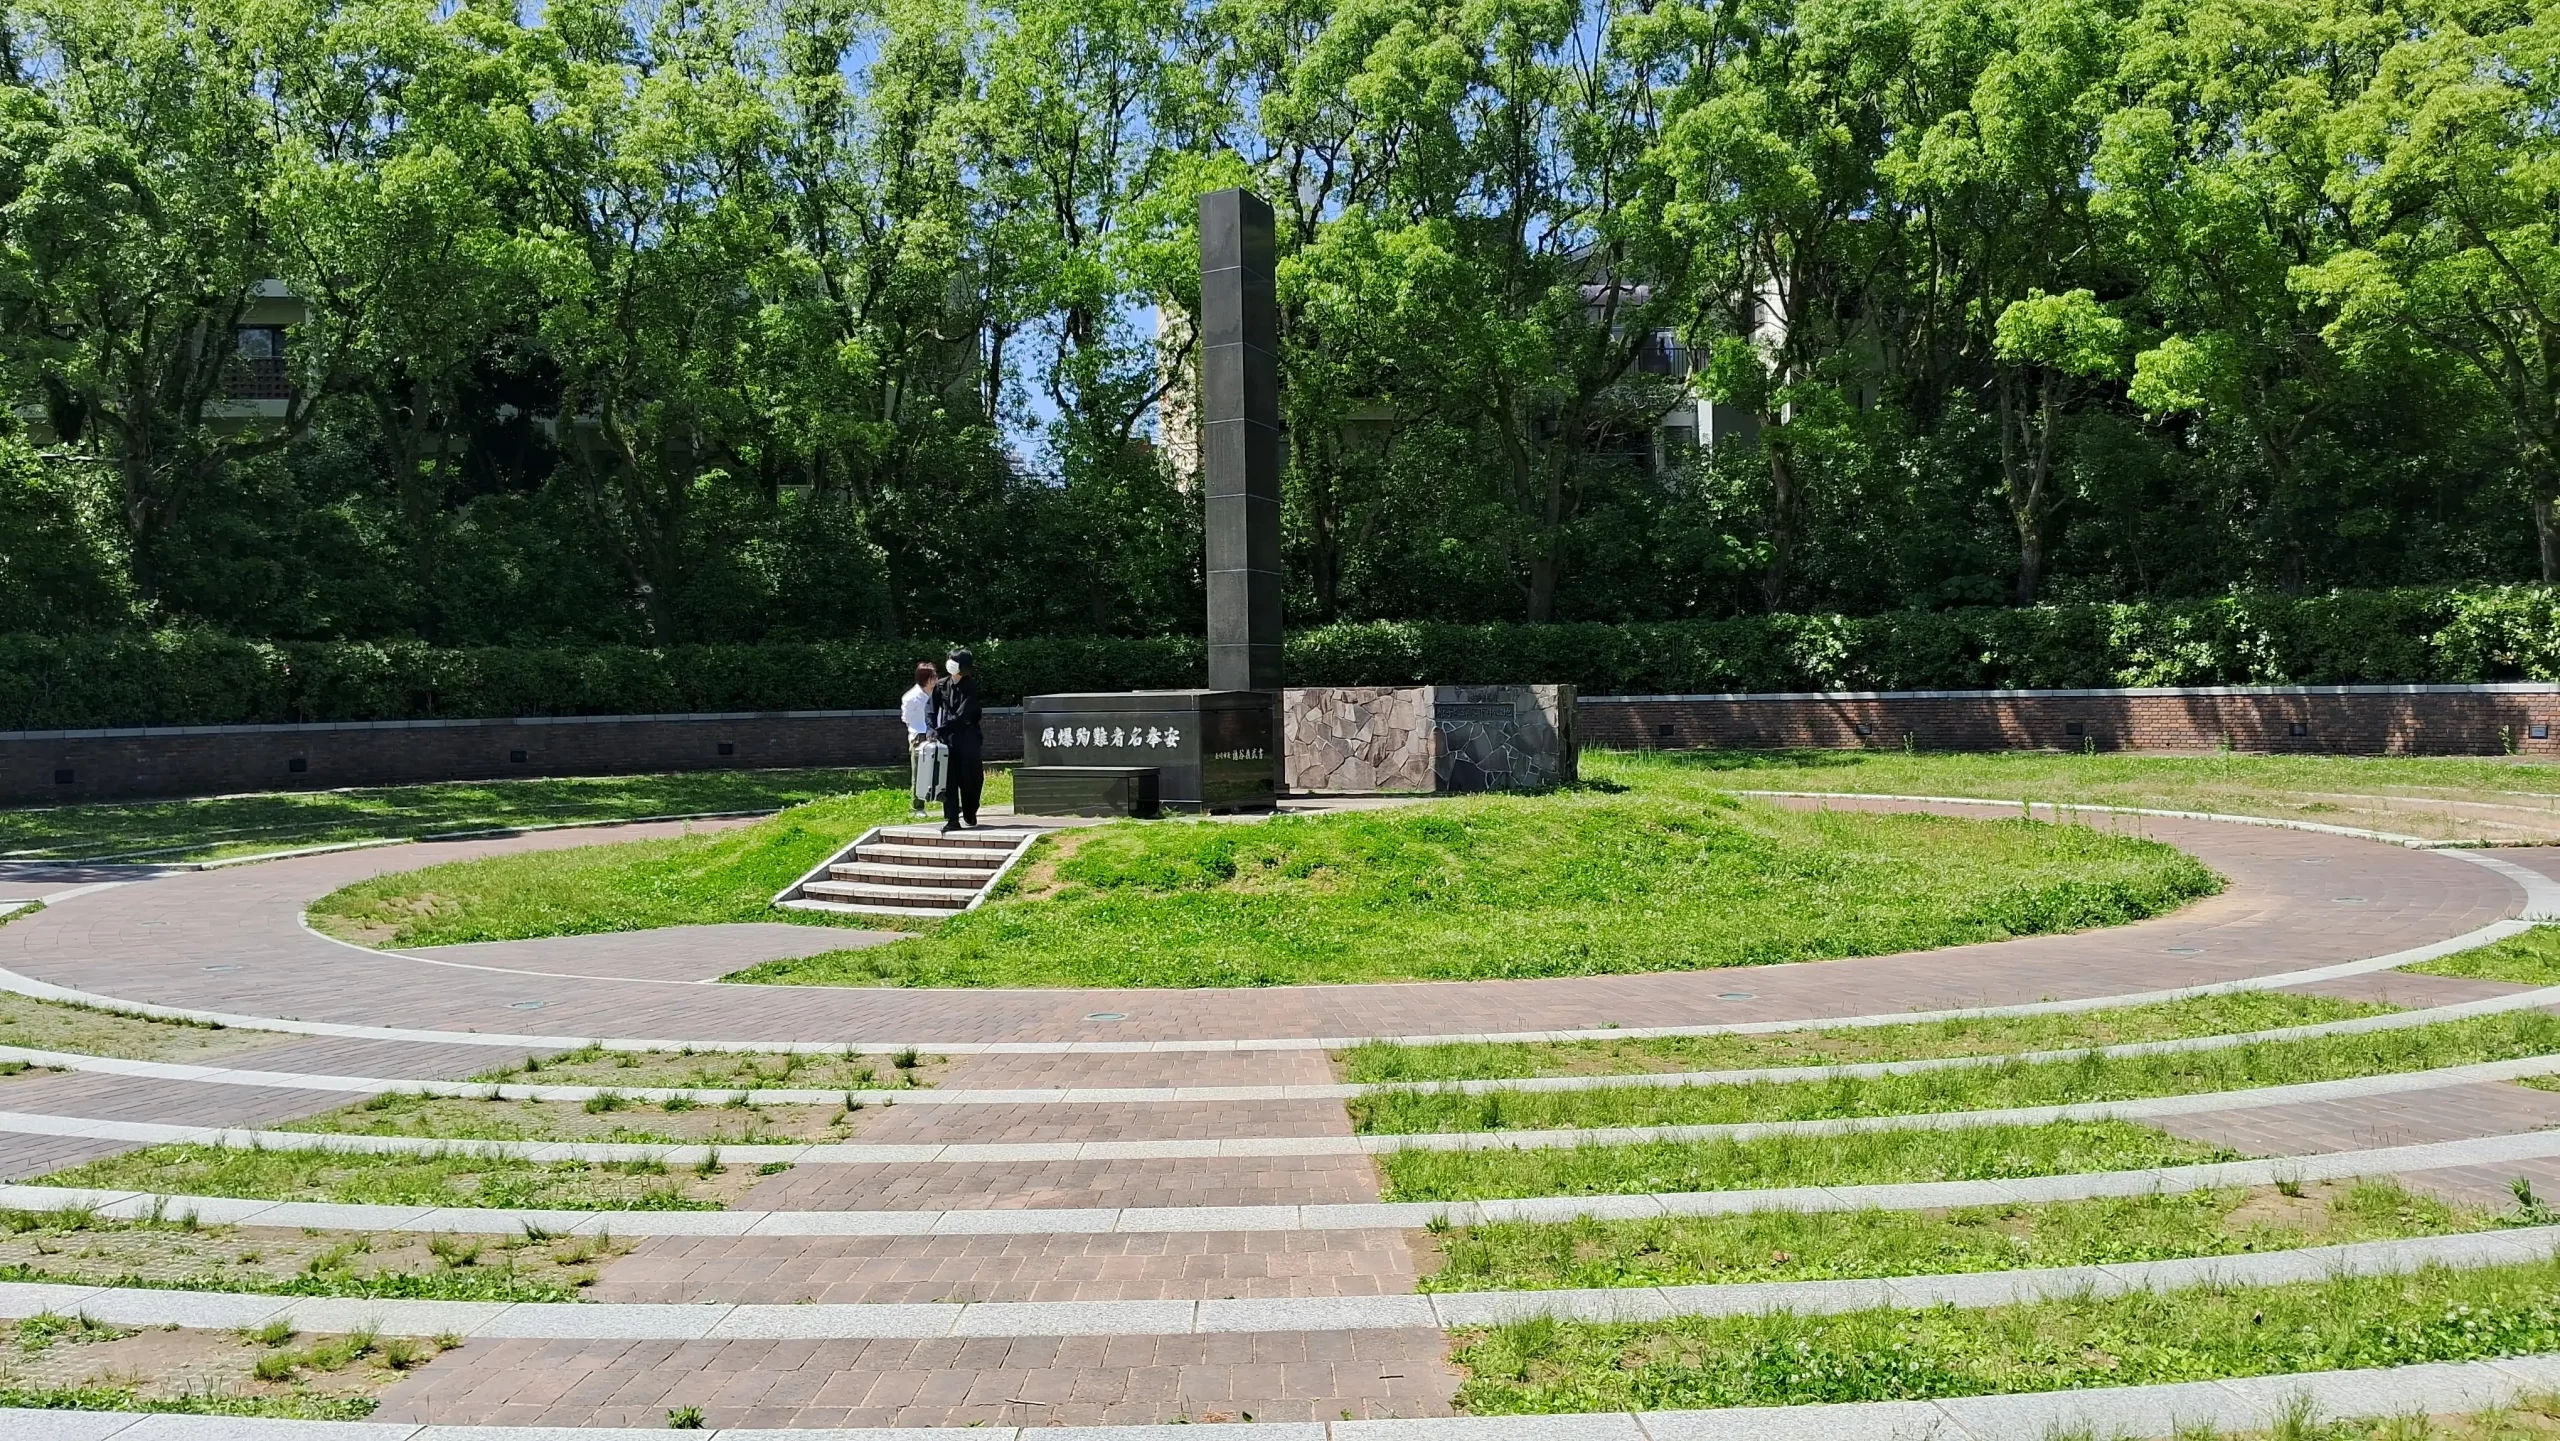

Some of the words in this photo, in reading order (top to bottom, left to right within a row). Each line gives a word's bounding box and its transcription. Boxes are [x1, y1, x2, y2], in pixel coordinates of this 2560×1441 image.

[1041, 726, 1181, 748] 原爆殉難者名奉安
